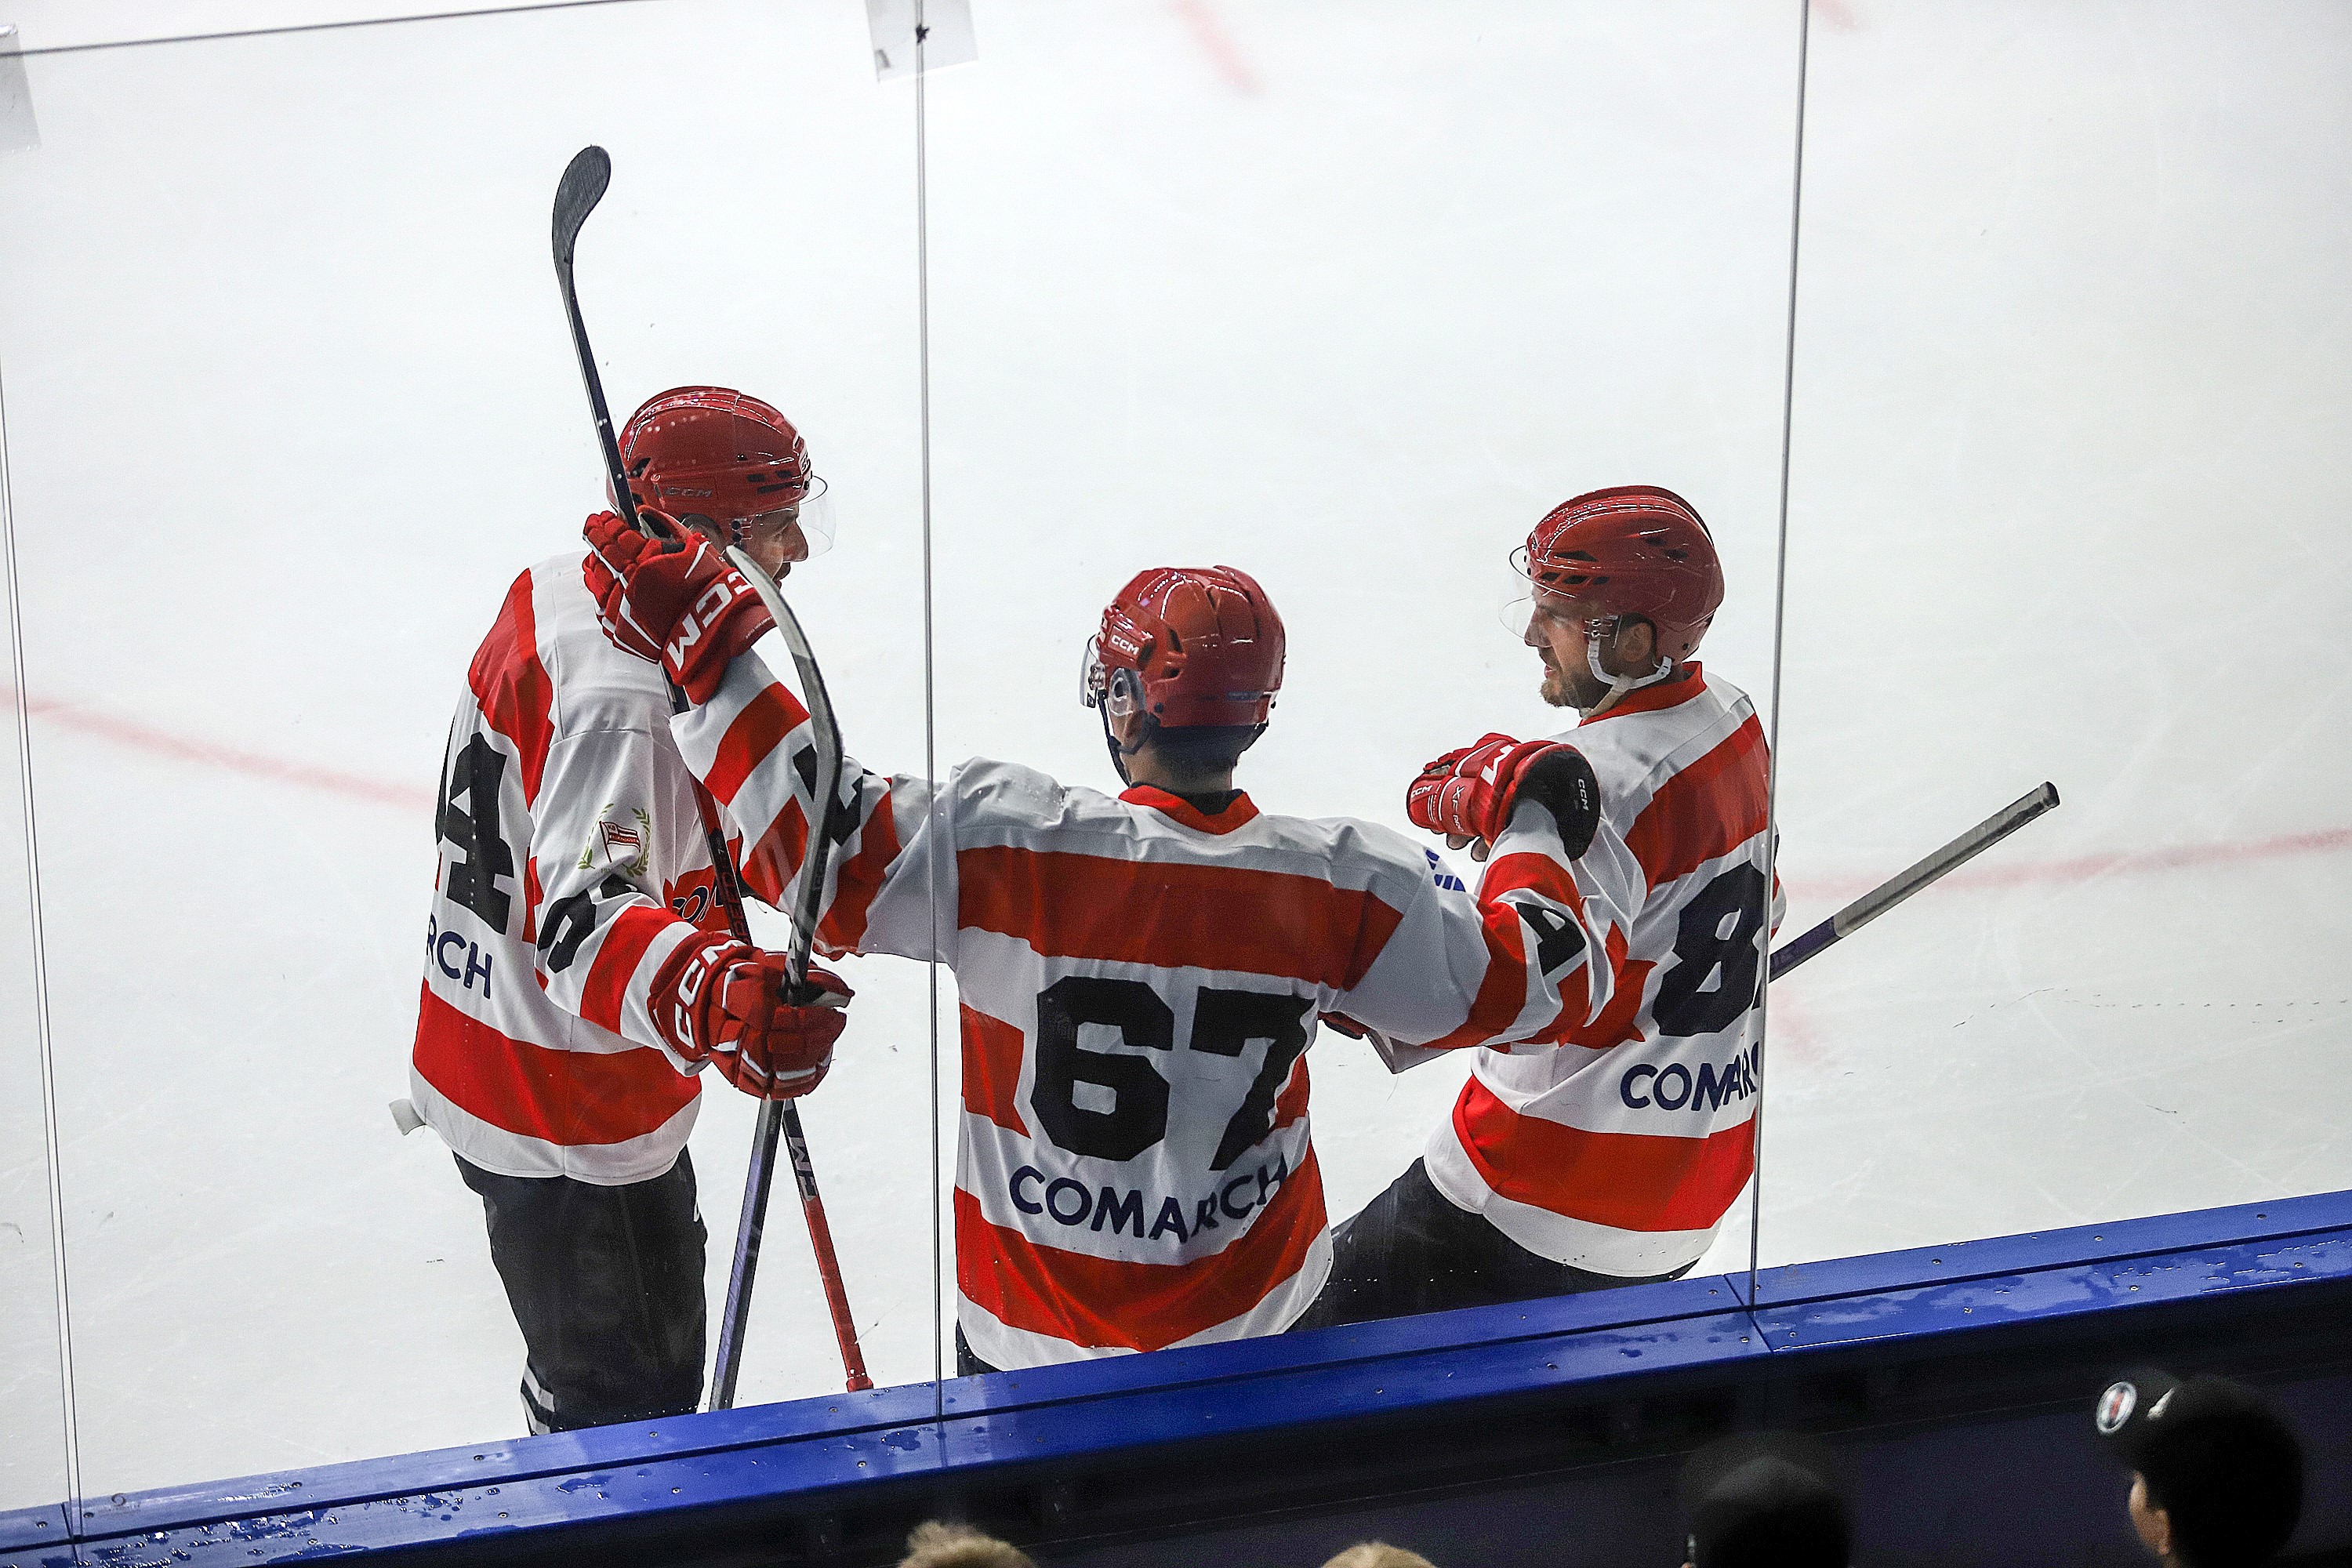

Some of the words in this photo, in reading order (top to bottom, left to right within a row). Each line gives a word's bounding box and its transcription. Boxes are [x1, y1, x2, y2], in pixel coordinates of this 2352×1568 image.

[1111, 634, 1140, 655] CCM
[1410, 785, 1433, 798] CCM
[1578, 779, 1590, 811] CCM
[1651, 859, 1765, 1037] 8
[1030, 975, 1316, 1171] 67
[1009, 1152, 1290, 1243] COMARCH
